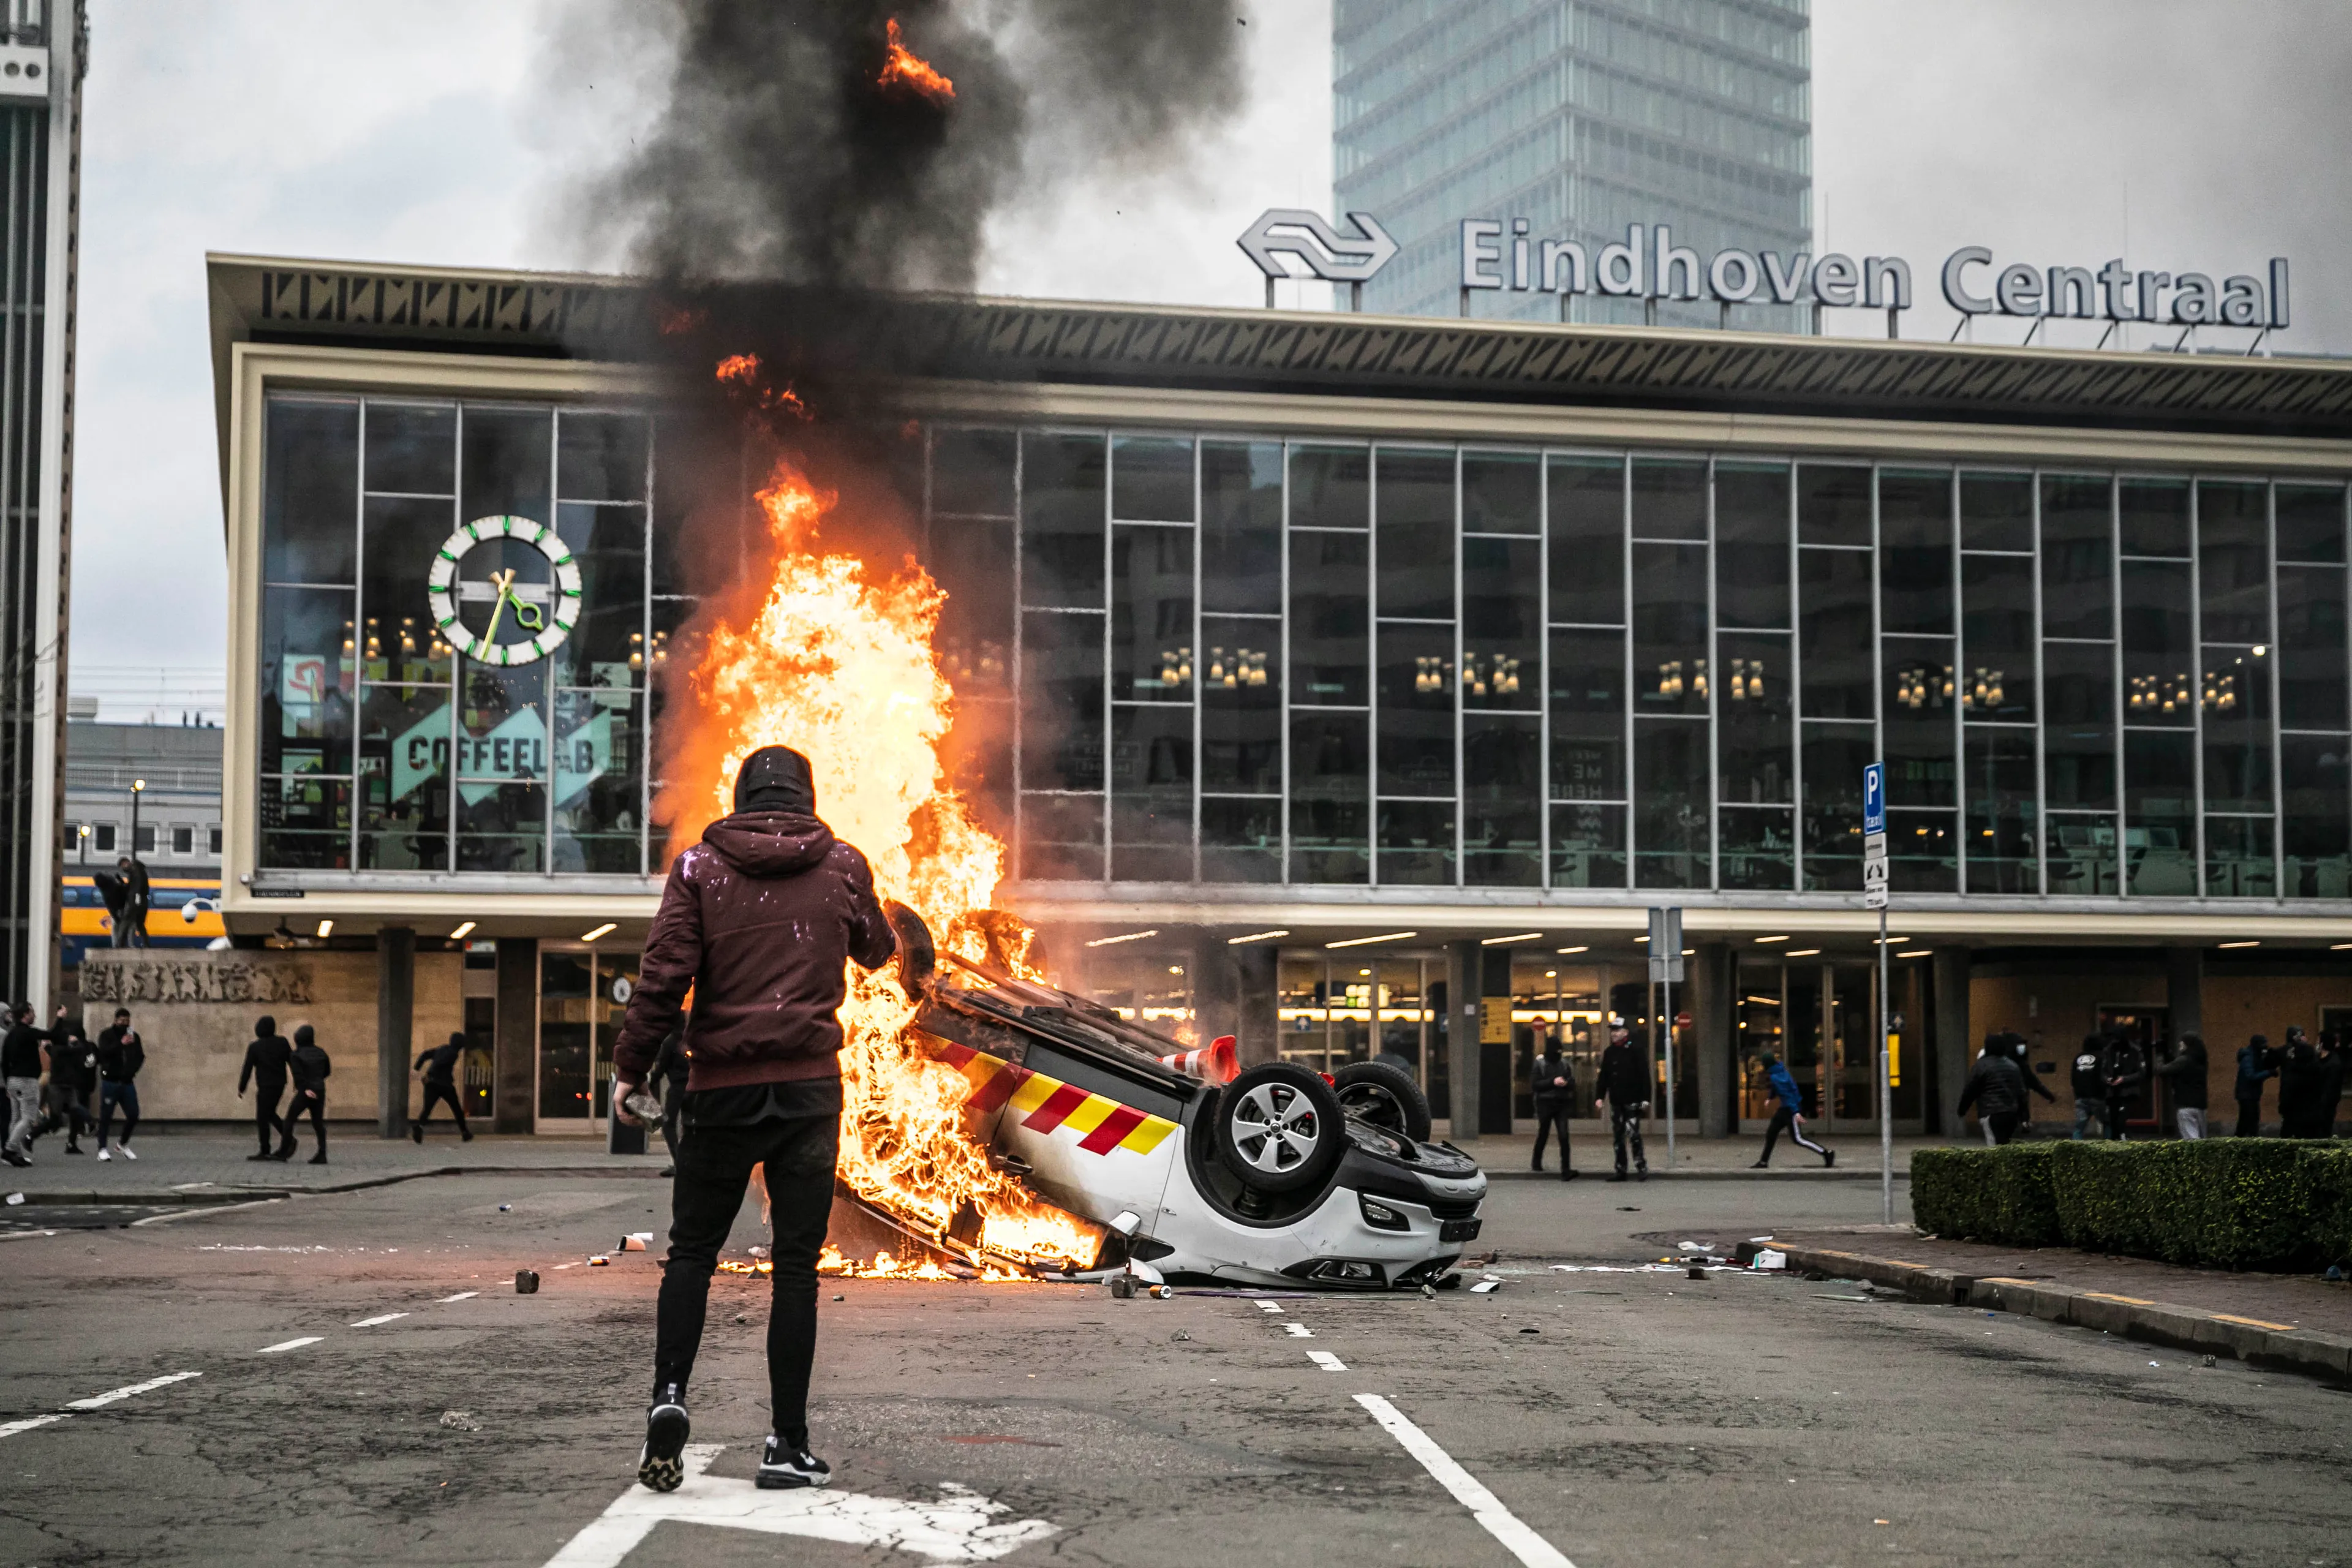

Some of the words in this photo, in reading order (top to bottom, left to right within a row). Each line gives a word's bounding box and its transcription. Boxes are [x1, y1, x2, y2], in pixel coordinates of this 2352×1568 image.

[1461, 218, 1912, 309] Eindhoven
[1941, 246, 2290, 329] Centraal
[1868, 770, 1879, 805] P
